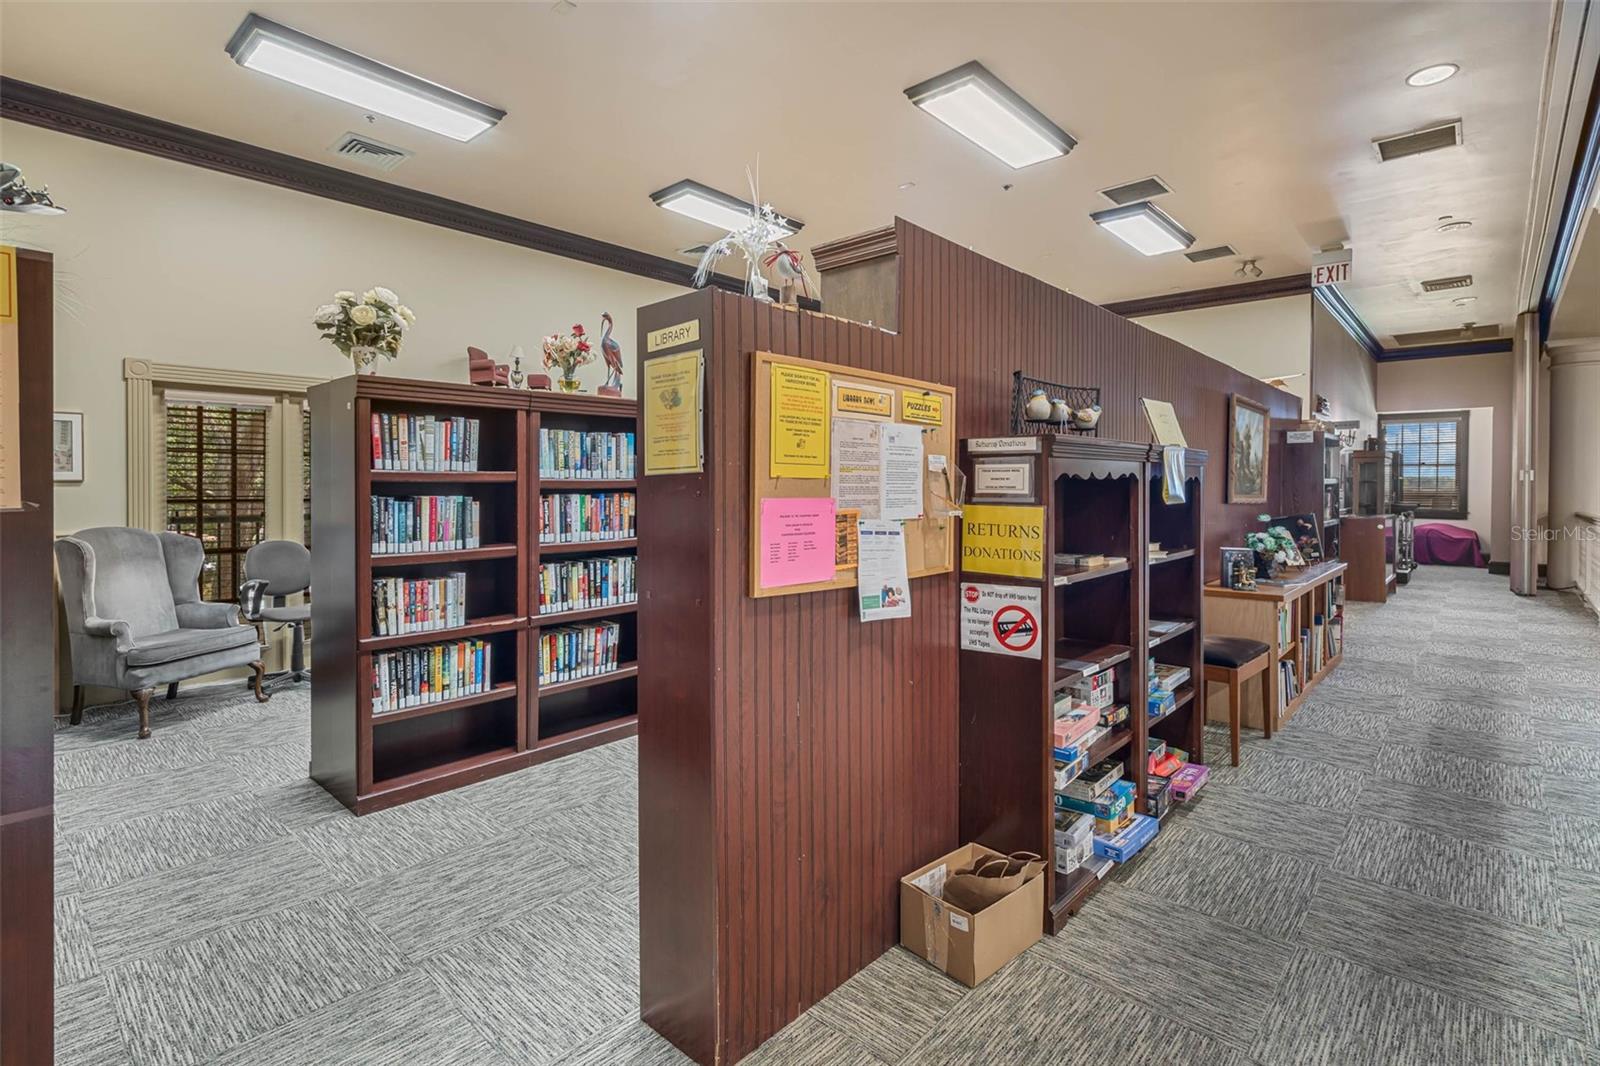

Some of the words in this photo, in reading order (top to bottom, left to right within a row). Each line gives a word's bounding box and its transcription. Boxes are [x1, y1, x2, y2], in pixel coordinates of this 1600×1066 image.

[1316, 264, 1349, 284] EXIT
[654, 326, 691, 346] LIBRARY
[907, 402, 932, 412] PUZZLES
[968, 522, 1040, 539] RETURNS
[964, 546, 1041, 562] DONATIONS
[980, 608, 994, 616] Library
[970, 630, 989, 638] accepting
